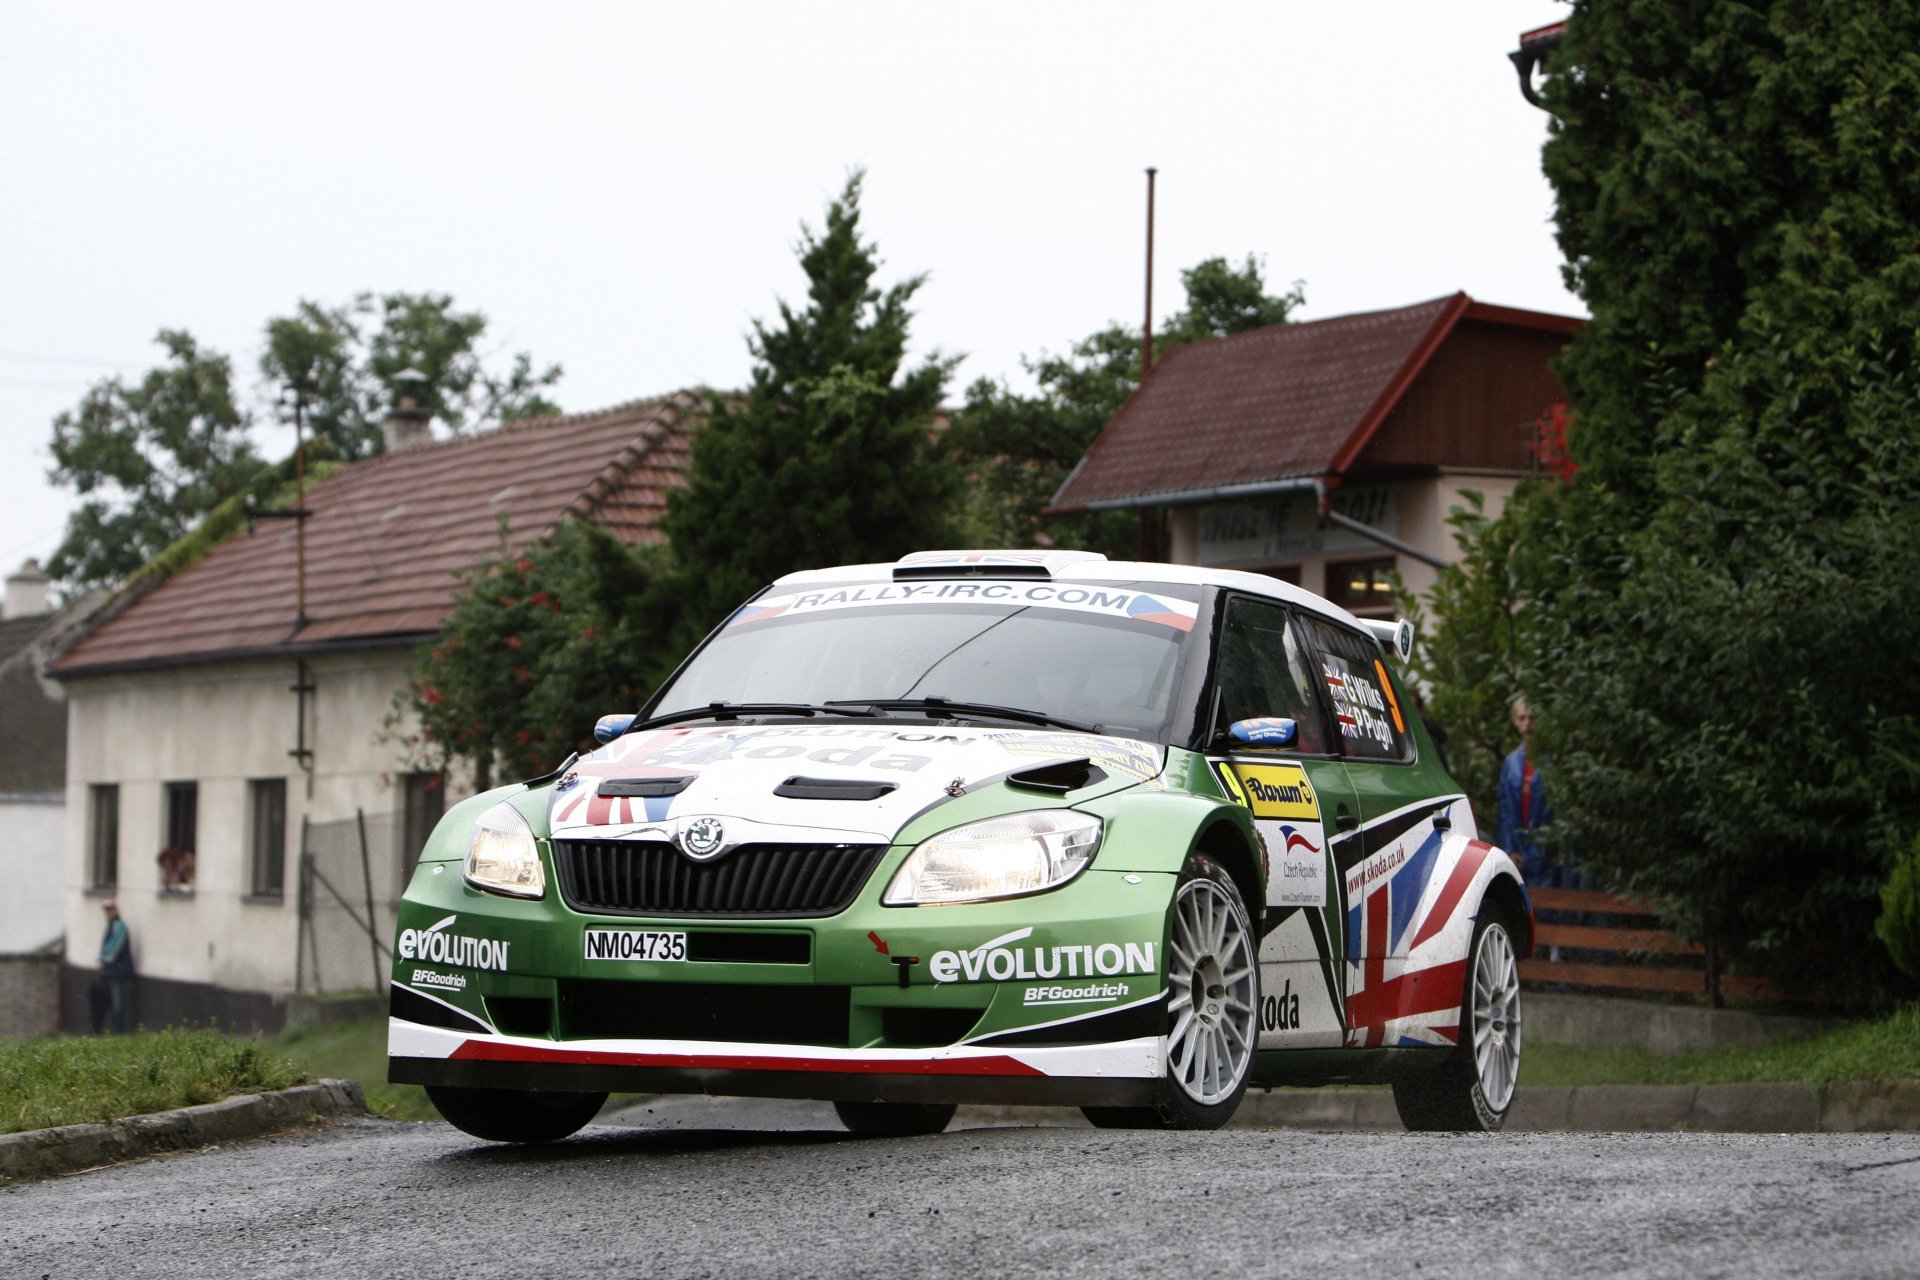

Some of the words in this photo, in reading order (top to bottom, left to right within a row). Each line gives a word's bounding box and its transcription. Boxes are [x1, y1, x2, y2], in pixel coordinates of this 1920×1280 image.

[794, 583, 1131, 611] RALLY-IRC.COM
[1342, 671, 1358, 703] G
[1350, 674, 1385, 712] Wilks
[1374, 658, 1405, 735] 9
[1352, 706, 1363, 737] P
[1361, 707, 1394, 751] Pugh
[1245, 776, 1303, 804] Barum
[1283, 861, 1299, 878] Czech
[1347, 842, 1406, 894] www.skoda.co.uk
[586, 930, 686, 960] NM04735
[411, 968, 467, 989] BFGoodrich
[1024, 983, 1129, 1002] BFGoodrich
[1259, 978, 1300, 1032] koda
